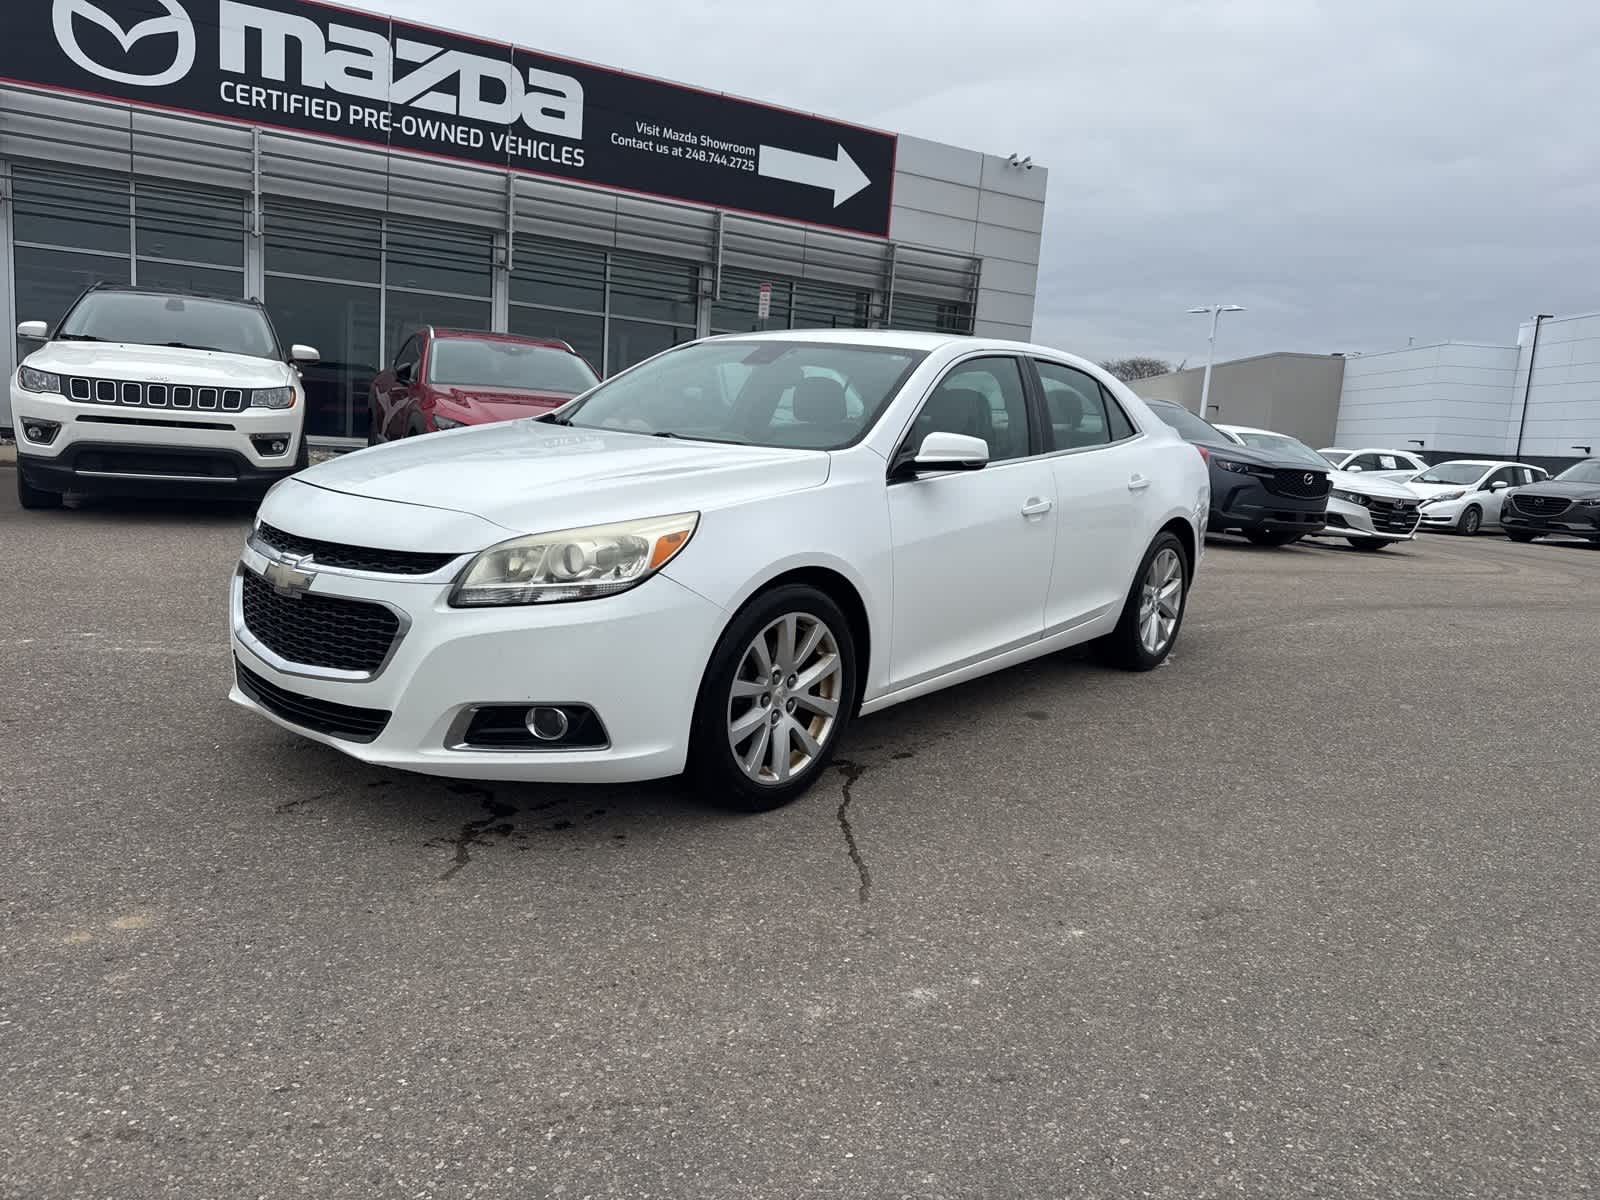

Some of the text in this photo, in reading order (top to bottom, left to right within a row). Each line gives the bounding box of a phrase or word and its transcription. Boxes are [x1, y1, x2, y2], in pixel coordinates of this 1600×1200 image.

[220, 81, 585, 167] CERTIFIED PRE-OWNED VEHICLES
[635, 120, 756, 157] Visit Mazda Showroom
[611, 132, 755, 171] Contact us at 248.744.2725
